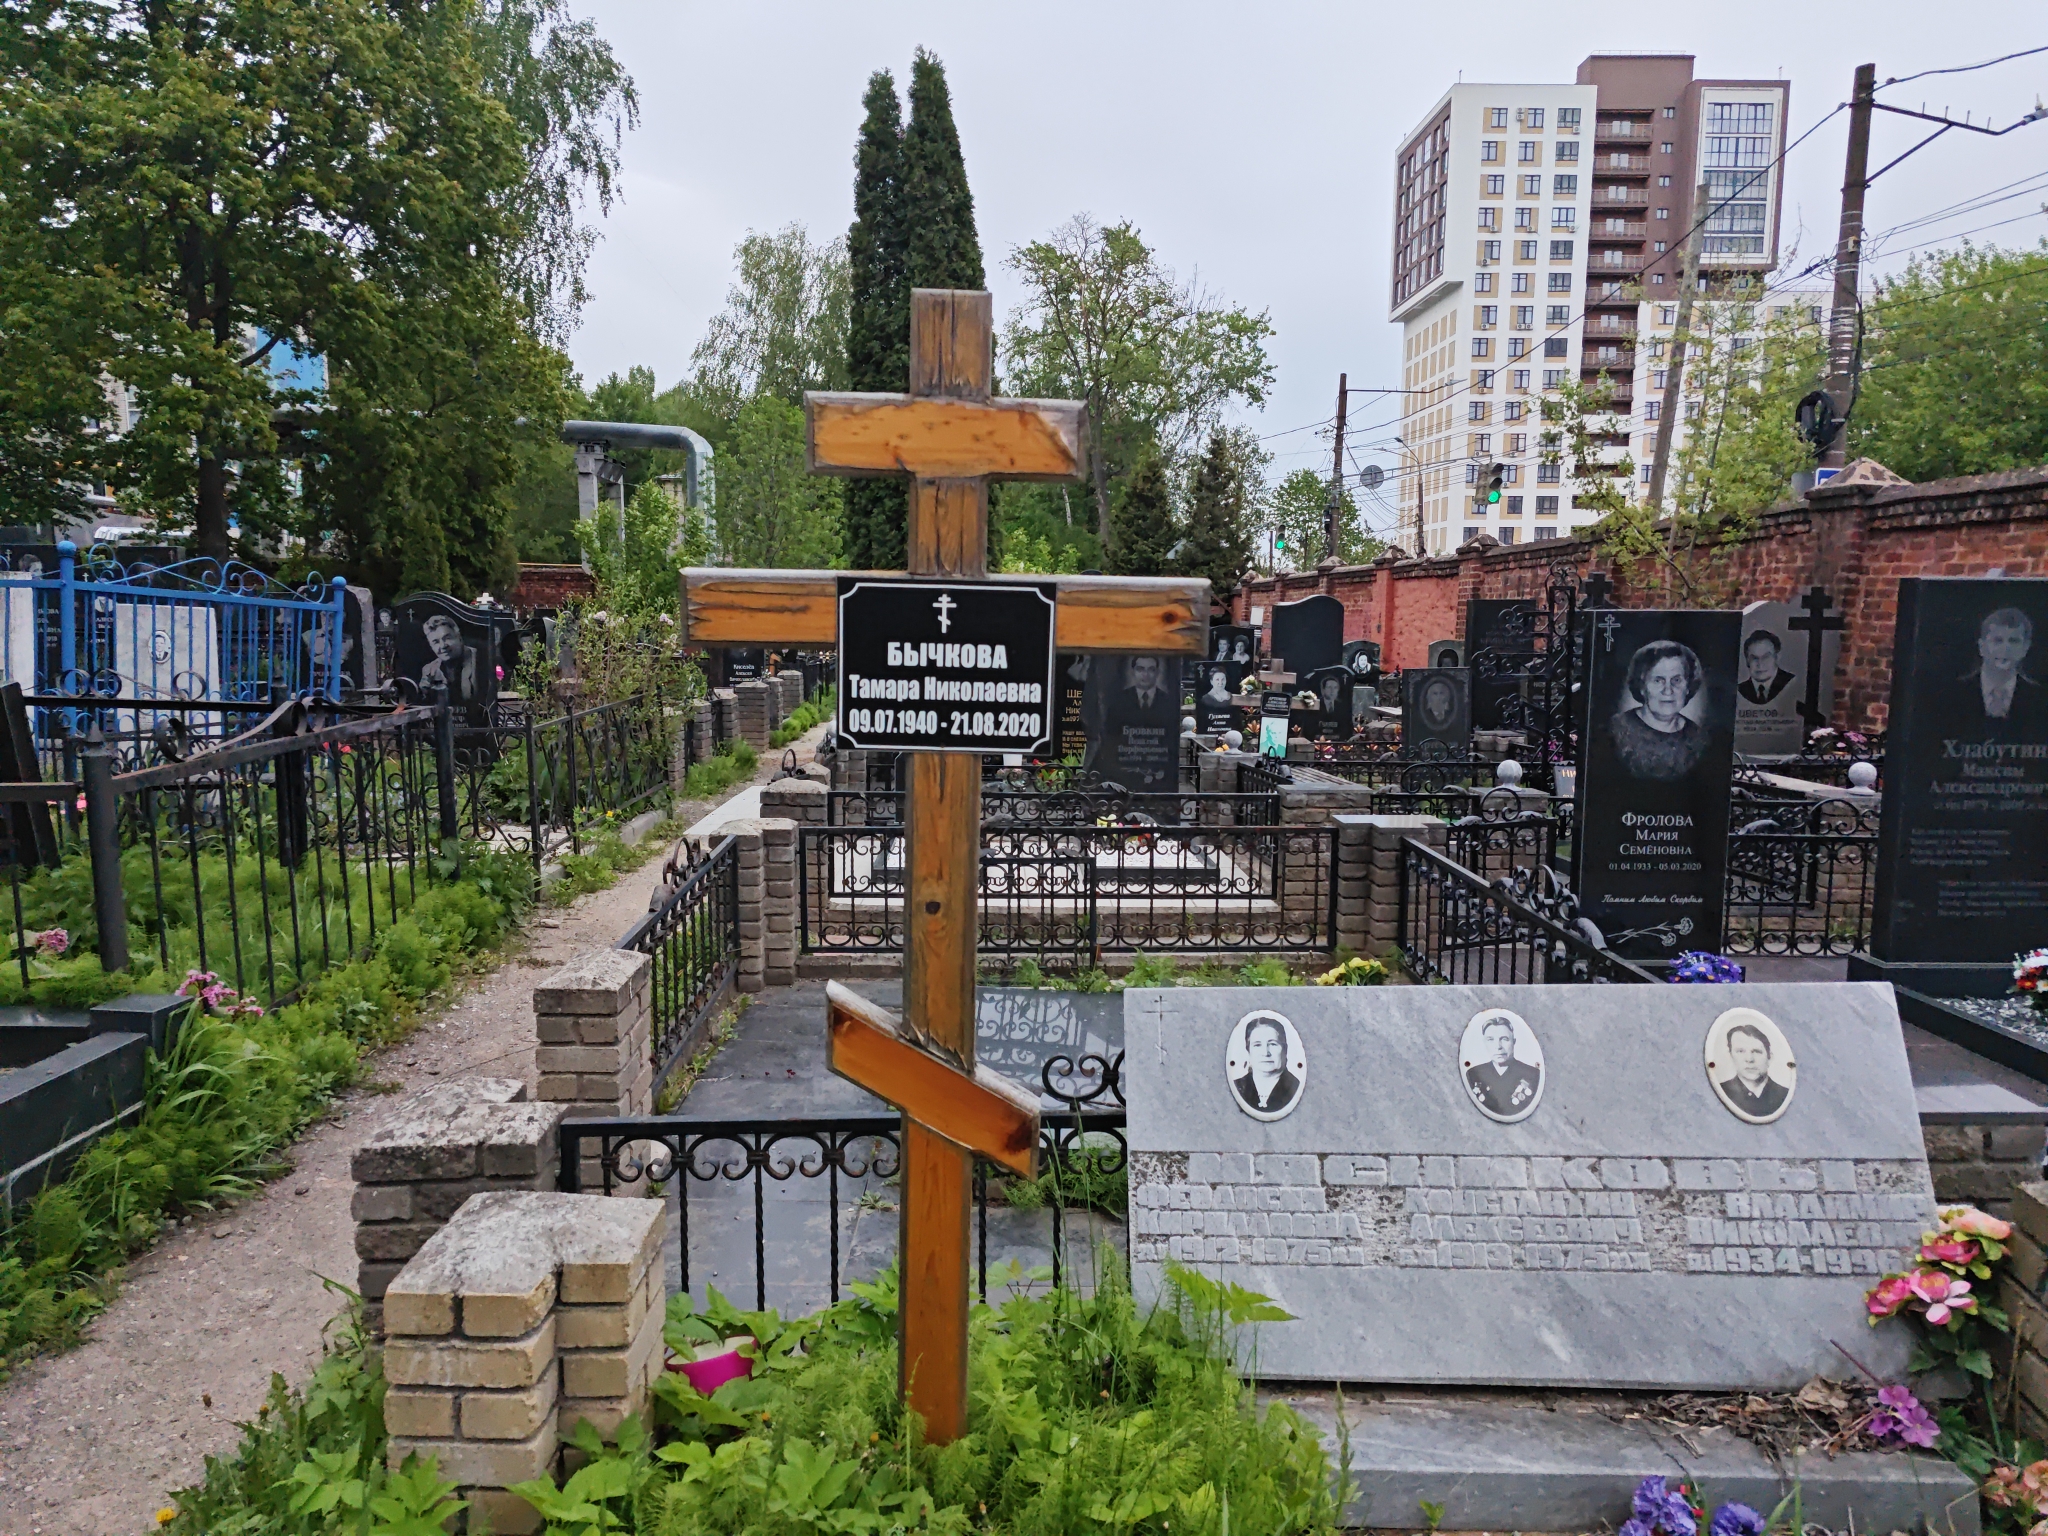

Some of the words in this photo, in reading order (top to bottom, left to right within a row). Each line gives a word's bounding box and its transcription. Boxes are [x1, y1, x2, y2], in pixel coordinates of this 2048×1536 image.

[887, 641, 1008, 669] БЫЧКОВА
[849, 674, 920, 702] Тамара
[924, 676, 1042, 703] Николаевна
[849, 708, 938, 734] 09.07.1940
[950, 711, 1041, 737] 21.08.2020
[1621, 812, 1694, 827] ФРОЛОВА
[1669, 894, 1704, 905] Скорбим
[1404, 1187, 1636, 1217] КОНСТАНТИН
[1410, 1212, 1643, 1245] АЛЕКСЕЕВИЧ
